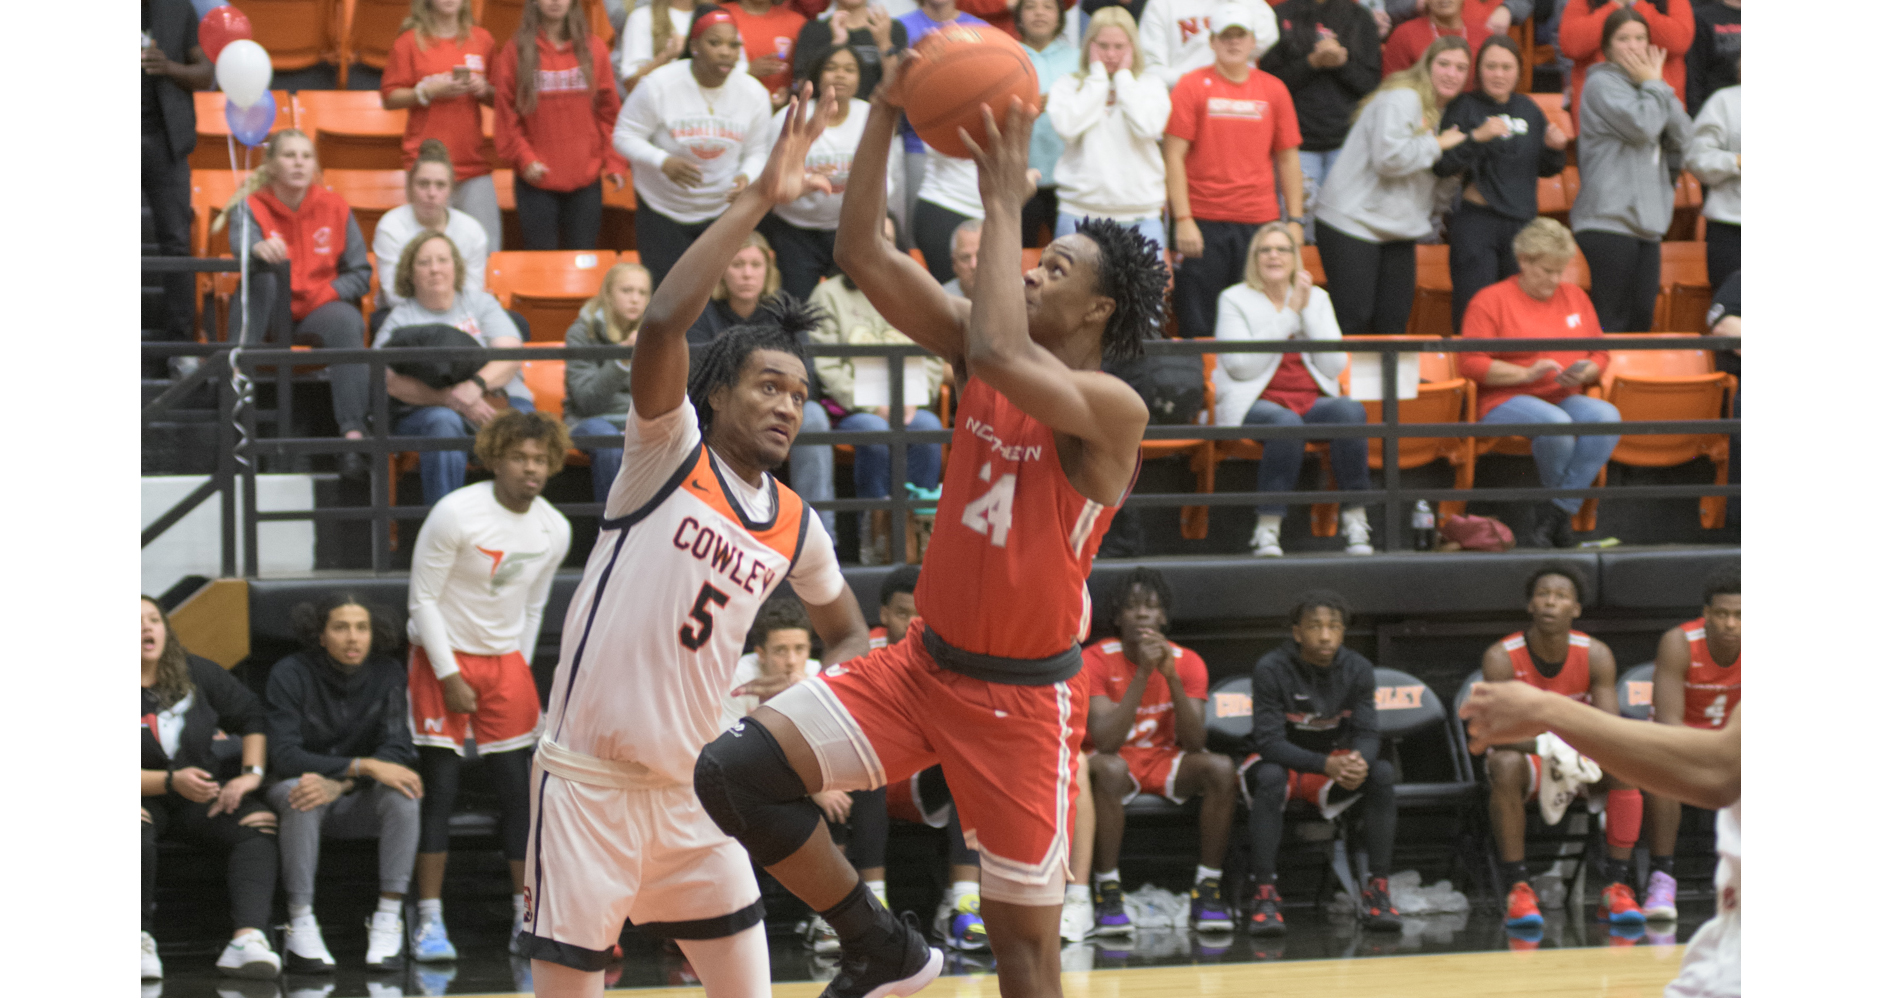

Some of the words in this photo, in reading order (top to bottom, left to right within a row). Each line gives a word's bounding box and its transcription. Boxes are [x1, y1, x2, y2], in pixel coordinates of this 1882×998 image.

[673, 516, 776, 600] COWLEY
[678, 579, 731, 654] 5
[1704, 694, 1729, 726] 4
